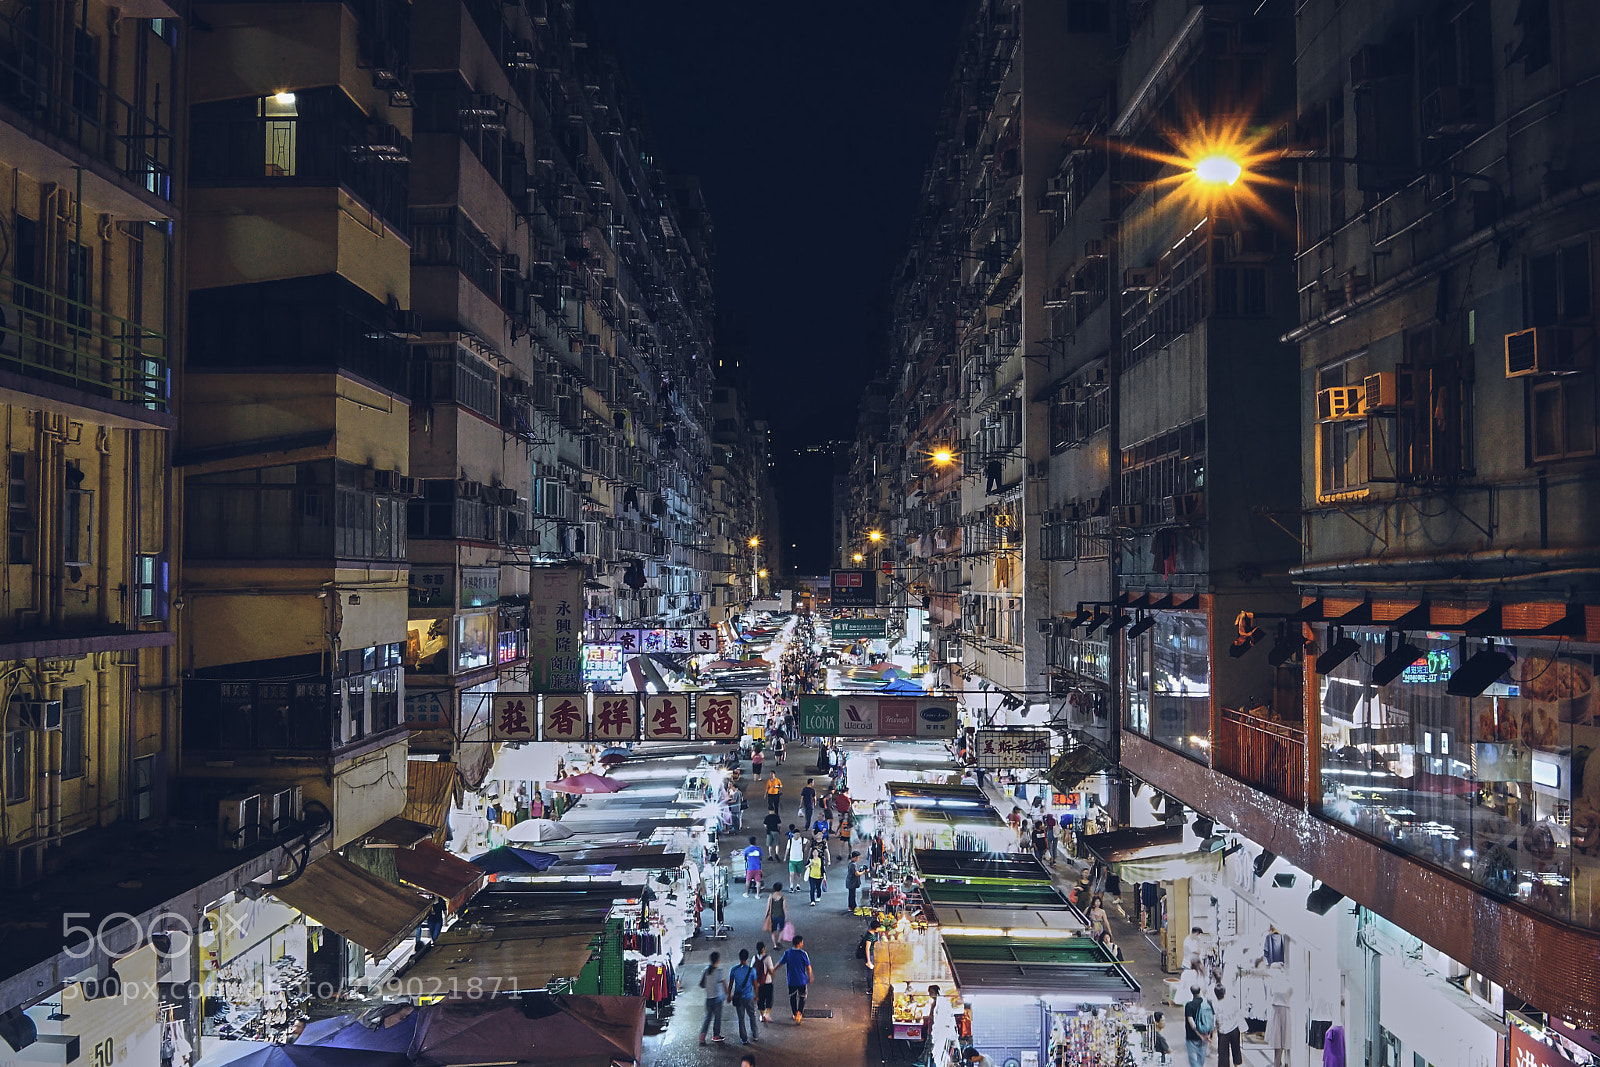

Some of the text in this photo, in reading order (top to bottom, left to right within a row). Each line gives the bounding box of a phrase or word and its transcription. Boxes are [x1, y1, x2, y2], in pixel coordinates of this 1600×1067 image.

[555, 600, 572, 653] 永興隆
[885, 715, 910, 725] Triumph
[844, 722, 873, 730] Wacoal
